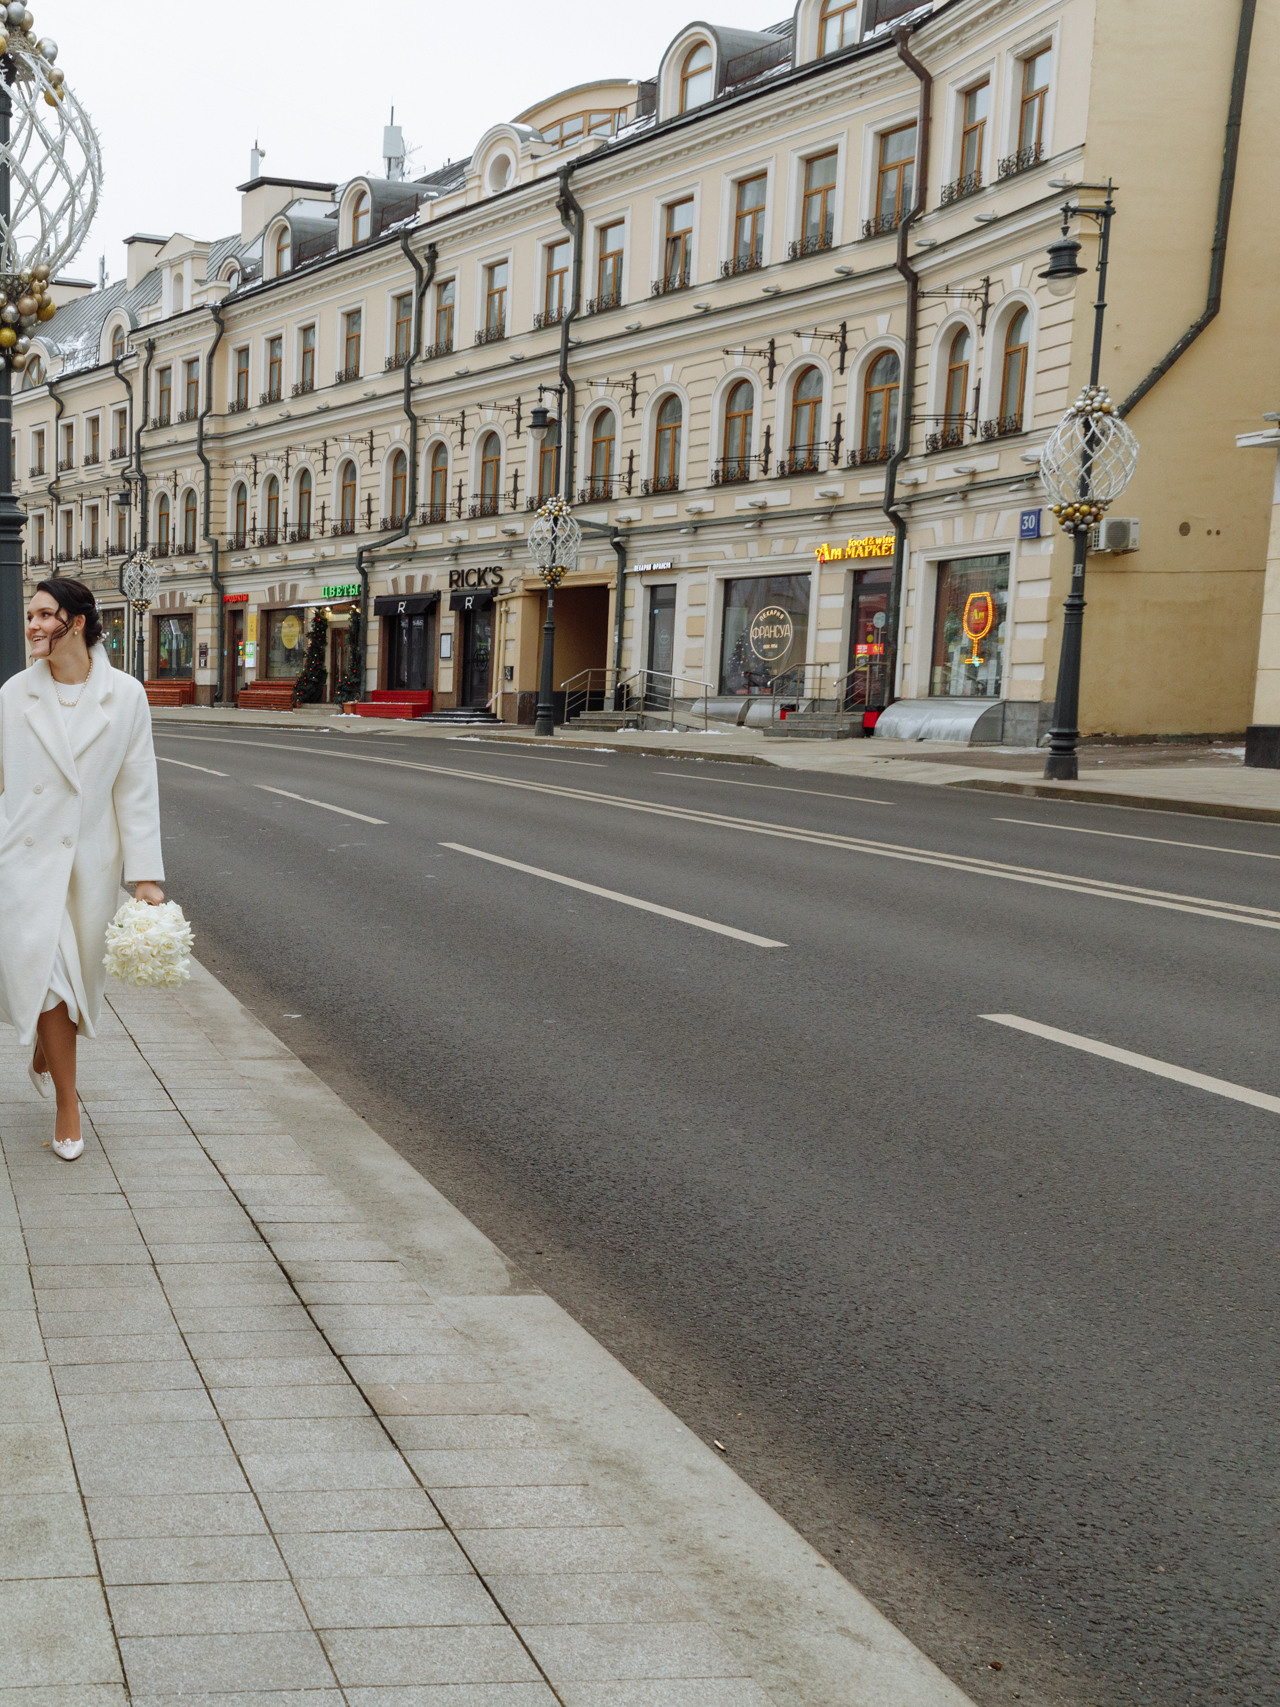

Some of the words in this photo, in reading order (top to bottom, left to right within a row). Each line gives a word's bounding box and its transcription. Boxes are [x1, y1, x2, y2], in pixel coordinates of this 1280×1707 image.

[1022, 514, 1036, 530] 30
[449, 566, 504, 588] RICK'S
[321, 584, 361, 599] ЦВЕТЫ
[759, 609, 785, 621] ПЕКАРНЯ
[752, 624, 791, 640] ФРАНСУА
